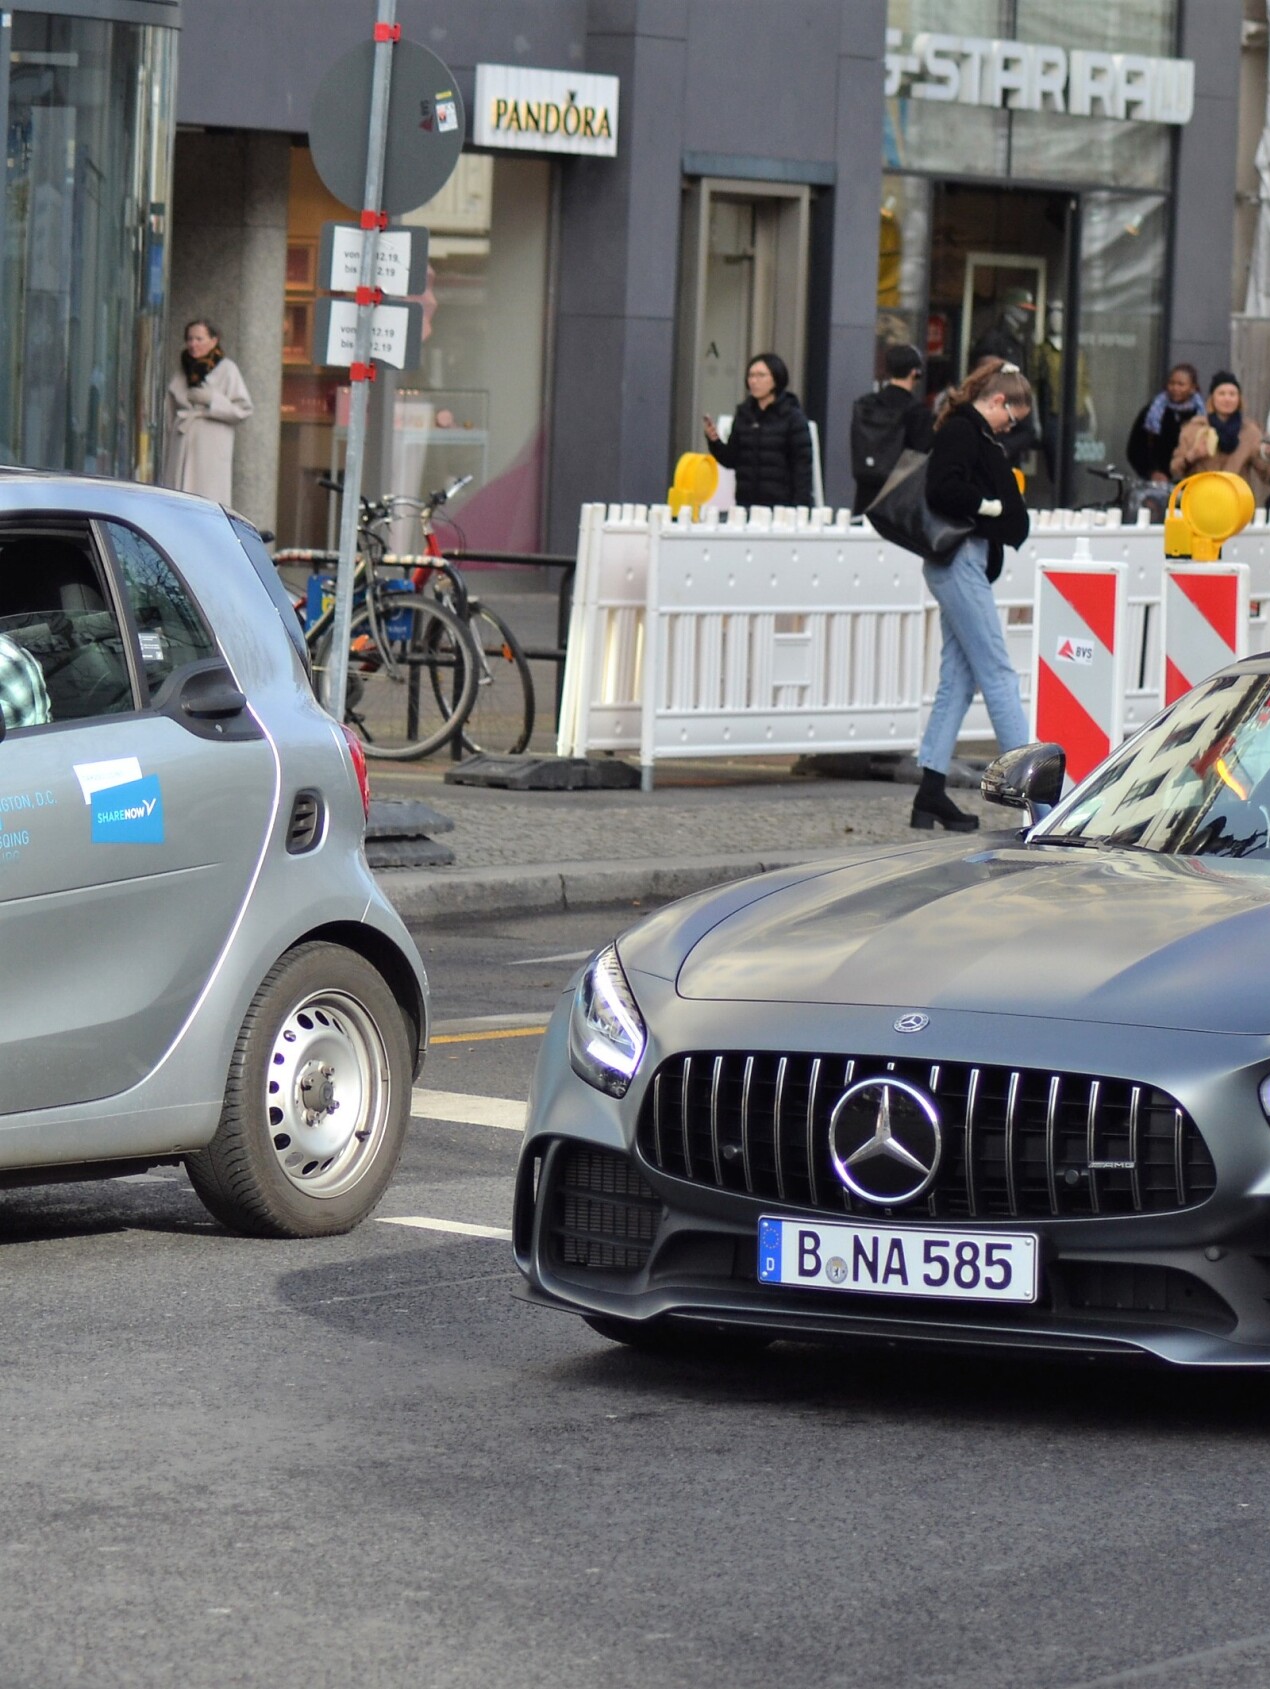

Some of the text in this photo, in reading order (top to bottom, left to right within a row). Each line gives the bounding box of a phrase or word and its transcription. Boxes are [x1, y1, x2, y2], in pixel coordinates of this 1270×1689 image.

[493, 93, 612, 138] PANDORA
[344, 250, 360, 259] von
[345, 264, 357, 273] bis
[340, 325, 357, 334] von
[340, 339, 354, 348] bis
[0, 794, 35, 812] GTON,
[97, 806, 145, 824] SHARENOW
[1100, 1161, 1135, 1169] AMG
[766, 1229, 1013, 1290] D B NA 585
